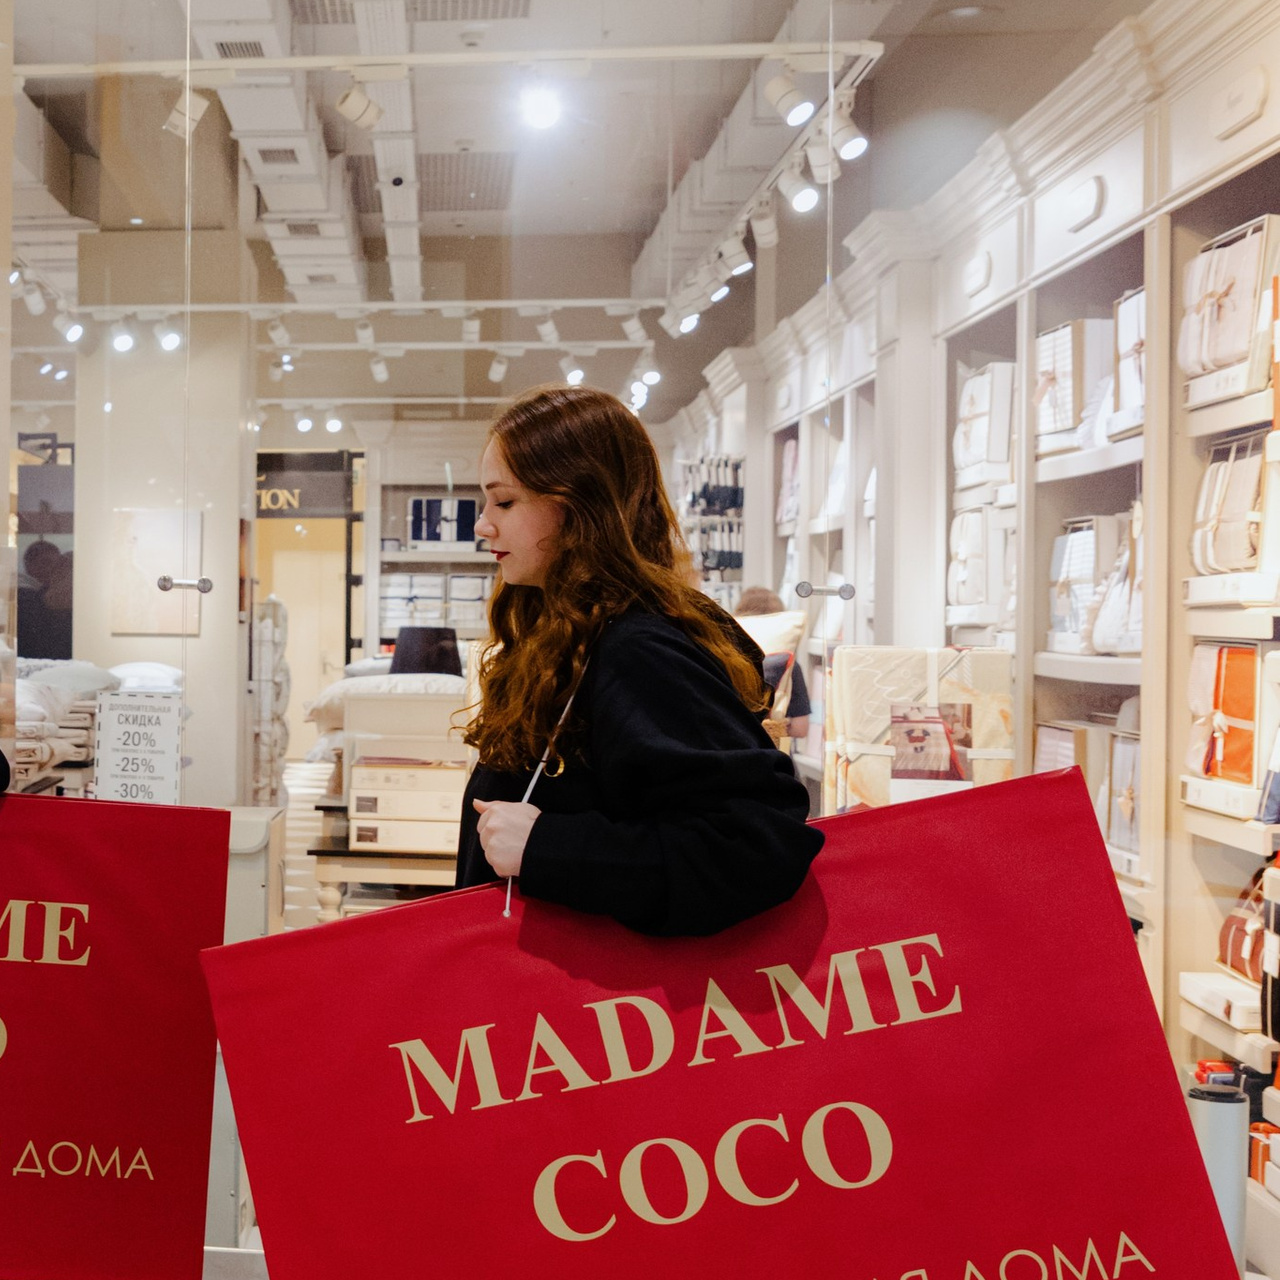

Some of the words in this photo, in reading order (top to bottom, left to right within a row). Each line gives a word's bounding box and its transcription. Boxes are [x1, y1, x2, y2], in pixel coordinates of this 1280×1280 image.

[256, 488, 300, 510] ION
[108, 703, 172, 713] ДОПОЛНИТЕЛЬНАЯ
[117, 713, 161, 727] СКИДКА
[116, 731, 156, 747] -20%
[115, 757, 155, 773] -25%
[114, 783, 154, 799] -30%
[389, 932, 963, 1124] MADAME
[12, 1140, 154, 1181] ДОМА
[533, 1101, 893, 1242] COCO
